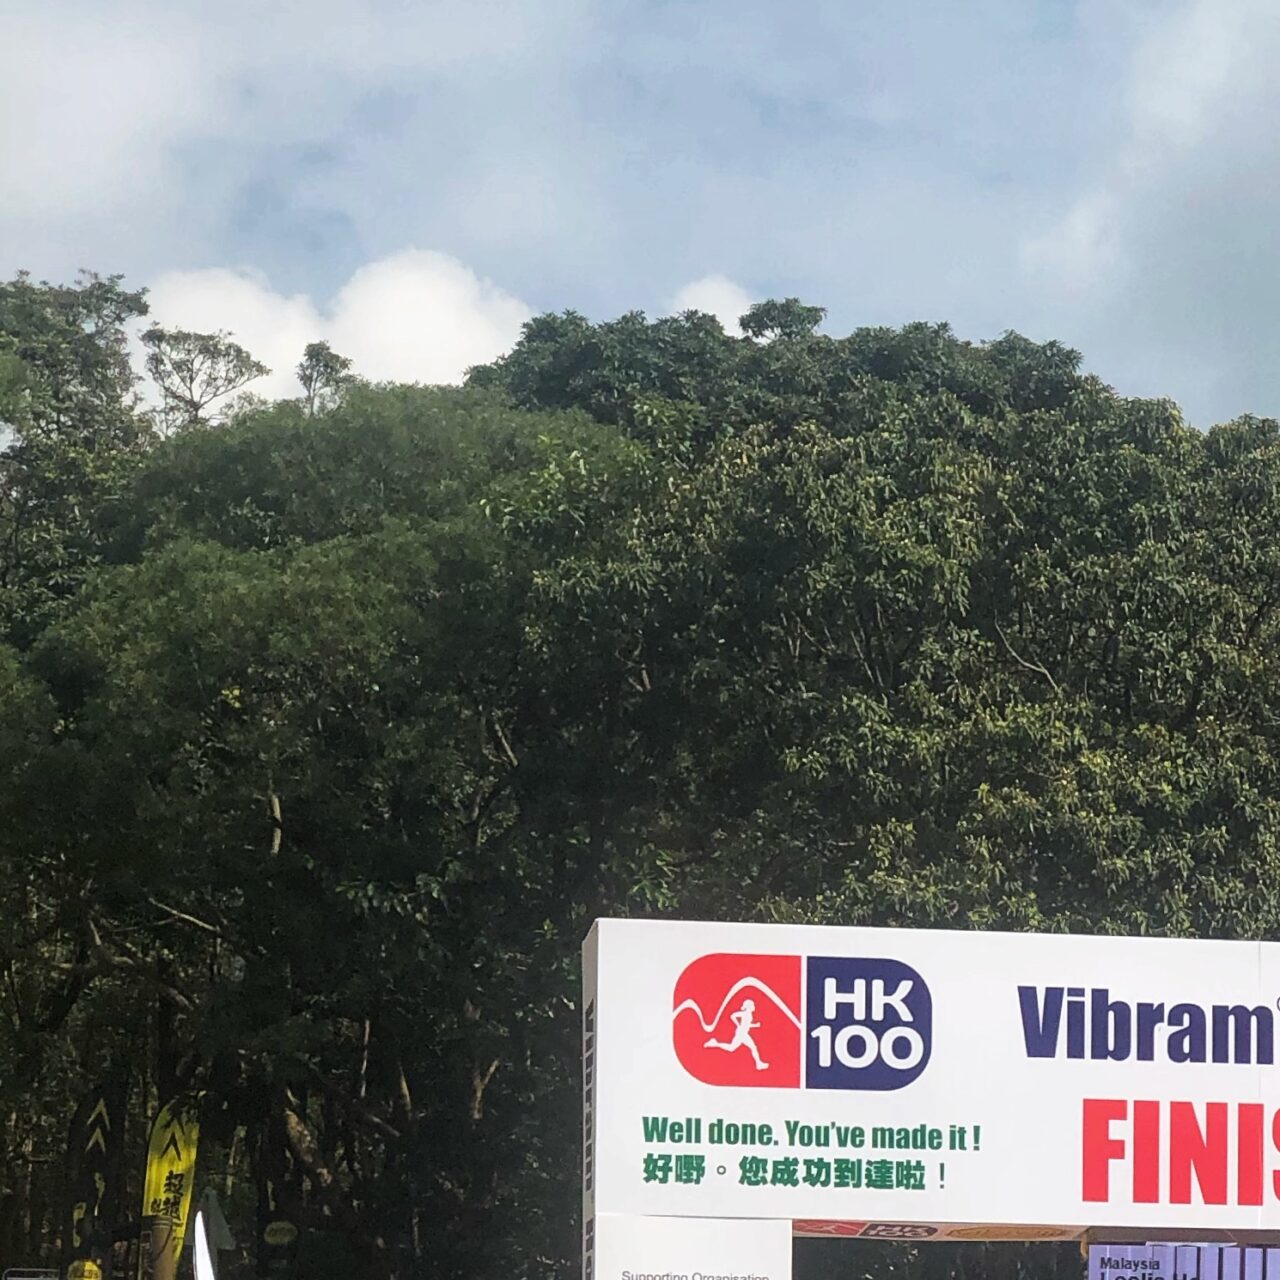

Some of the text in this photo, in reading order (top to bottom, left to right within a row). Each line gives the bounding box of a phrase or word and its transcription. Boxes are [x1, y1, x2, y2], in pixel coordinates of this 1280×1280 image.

[824, 977, 914, 1022] HK
[811, 1025, 924, 1069] 100
[642, 1116, 701, 1144] Well
[708, 1118, 779, 1146] done.
[872, 1125, 943, 1150] made
[1100, 1257, 1160, 1271] Malaysia
